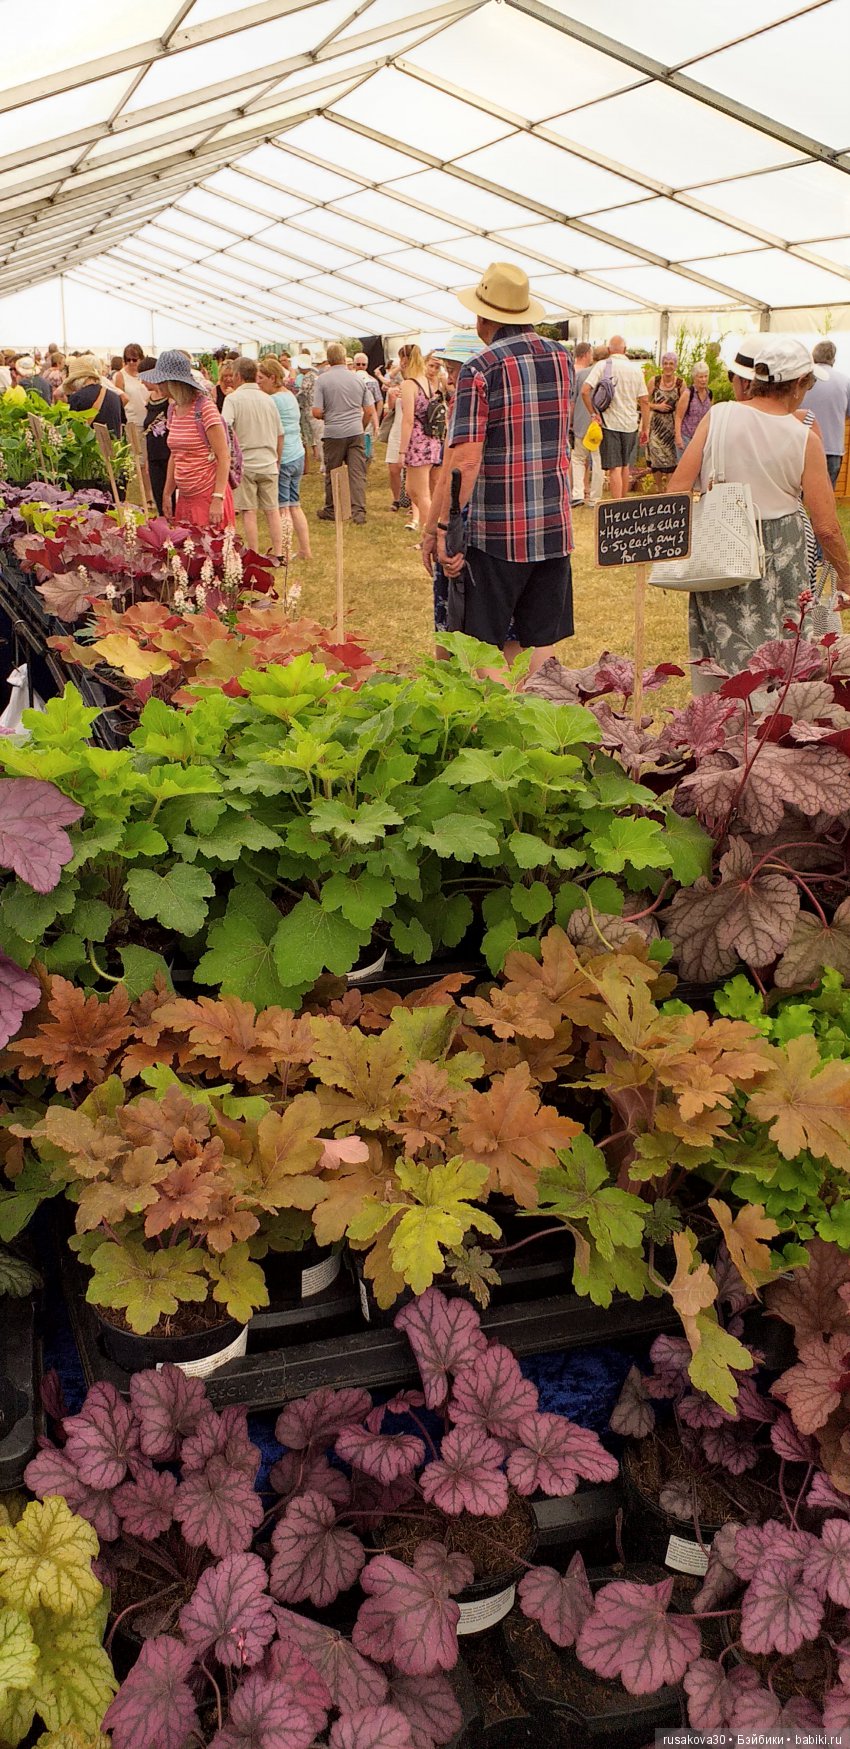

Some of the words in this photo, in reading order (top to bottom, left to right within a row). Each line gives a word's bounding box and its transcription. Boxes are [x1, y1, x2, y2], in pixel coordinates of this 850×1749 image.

[629, 534, 653, 548] each
[657, 535, 676, 546] any
[678, 531, 685, 543] 3
[621, 550, 637, 564] for
[648, 545, 682, 559] 18-00
